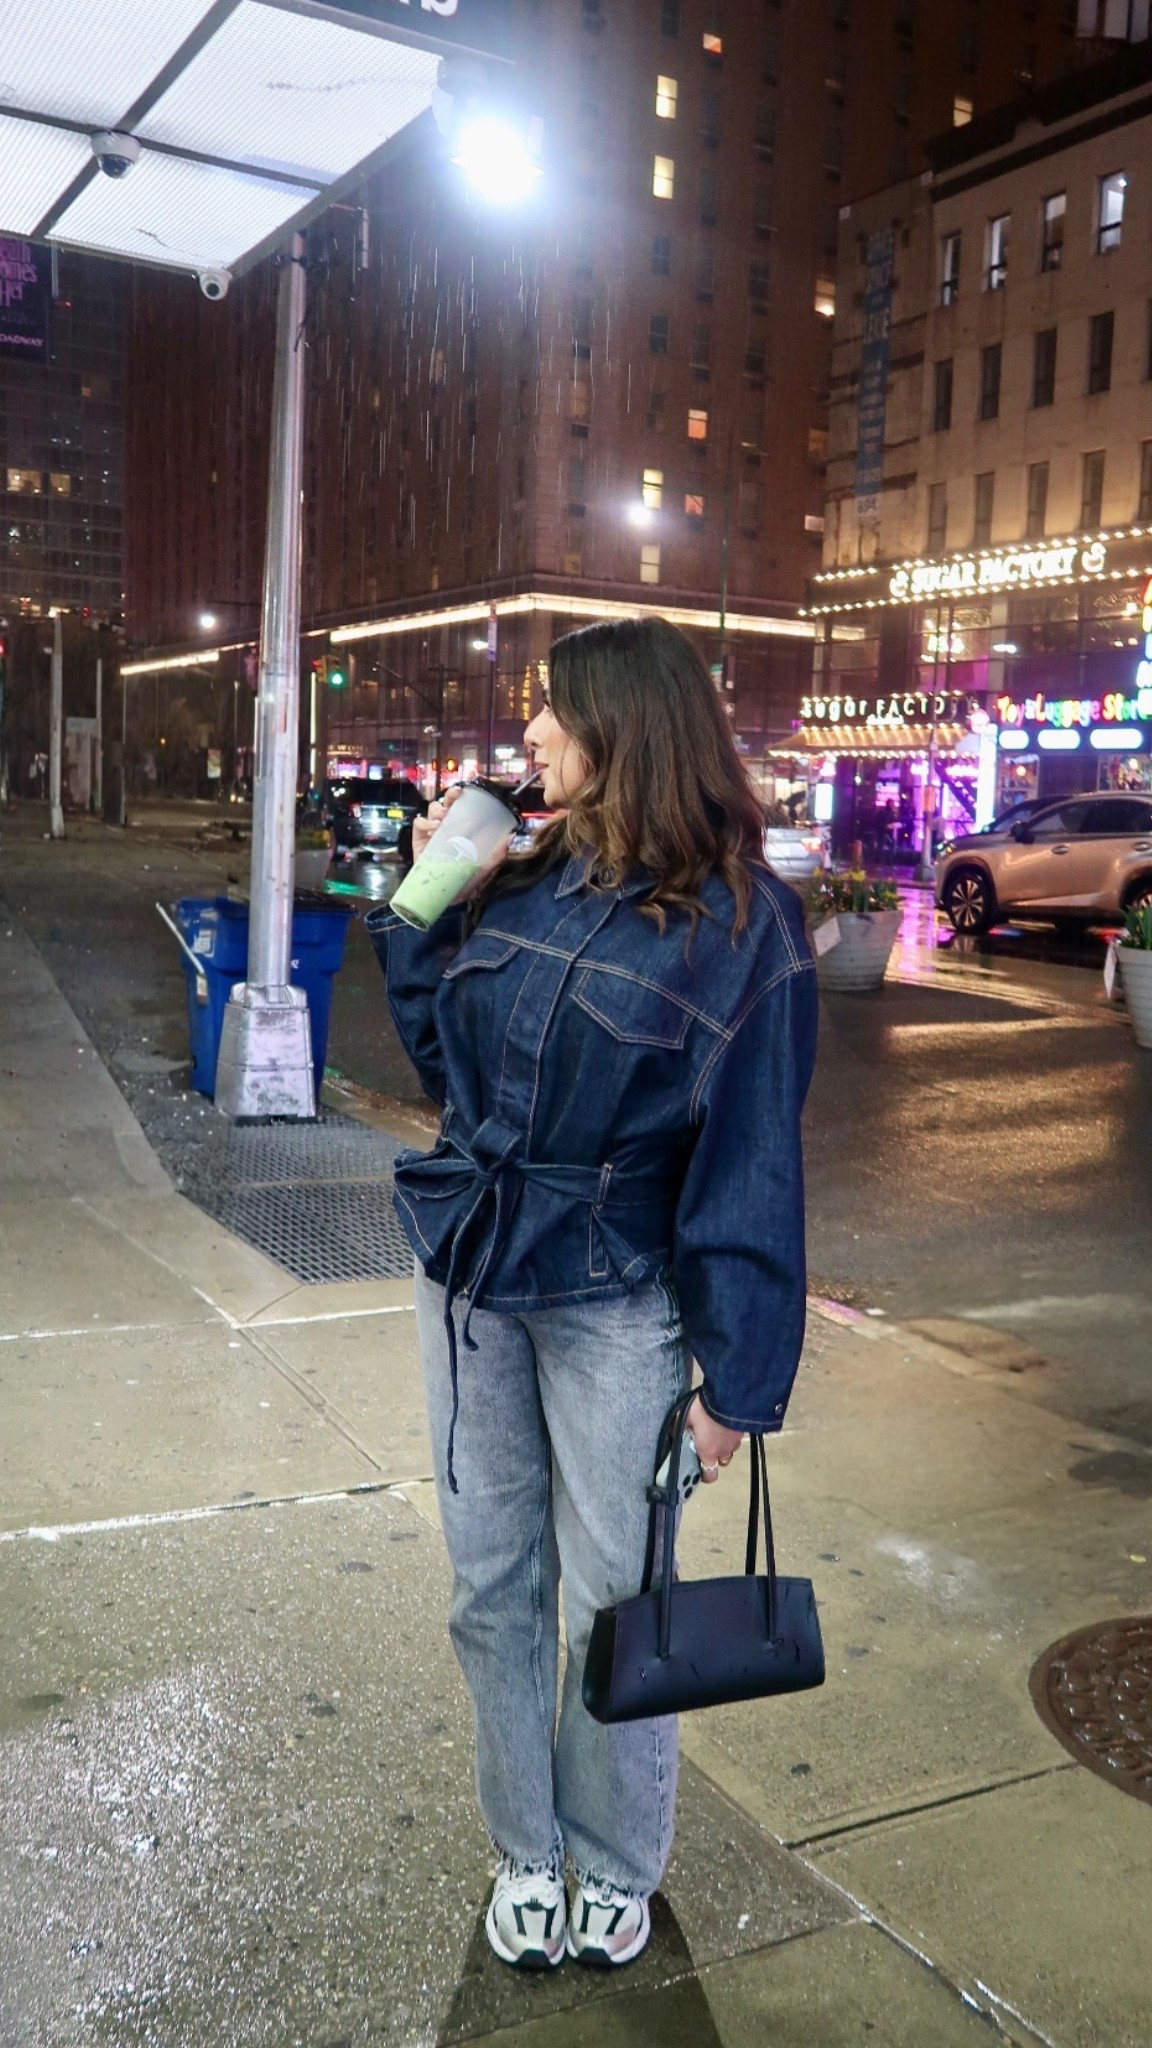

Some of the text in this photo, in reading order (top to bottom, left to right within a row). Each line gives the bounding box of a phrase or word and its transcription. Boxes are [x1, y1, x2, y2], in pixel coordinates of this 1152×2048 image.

[911, 547, 1077, 594] SUGAR FACTORY
[997, 694, 1025, 727] Toy
[1035, 692, 1100, 728] Luggage
